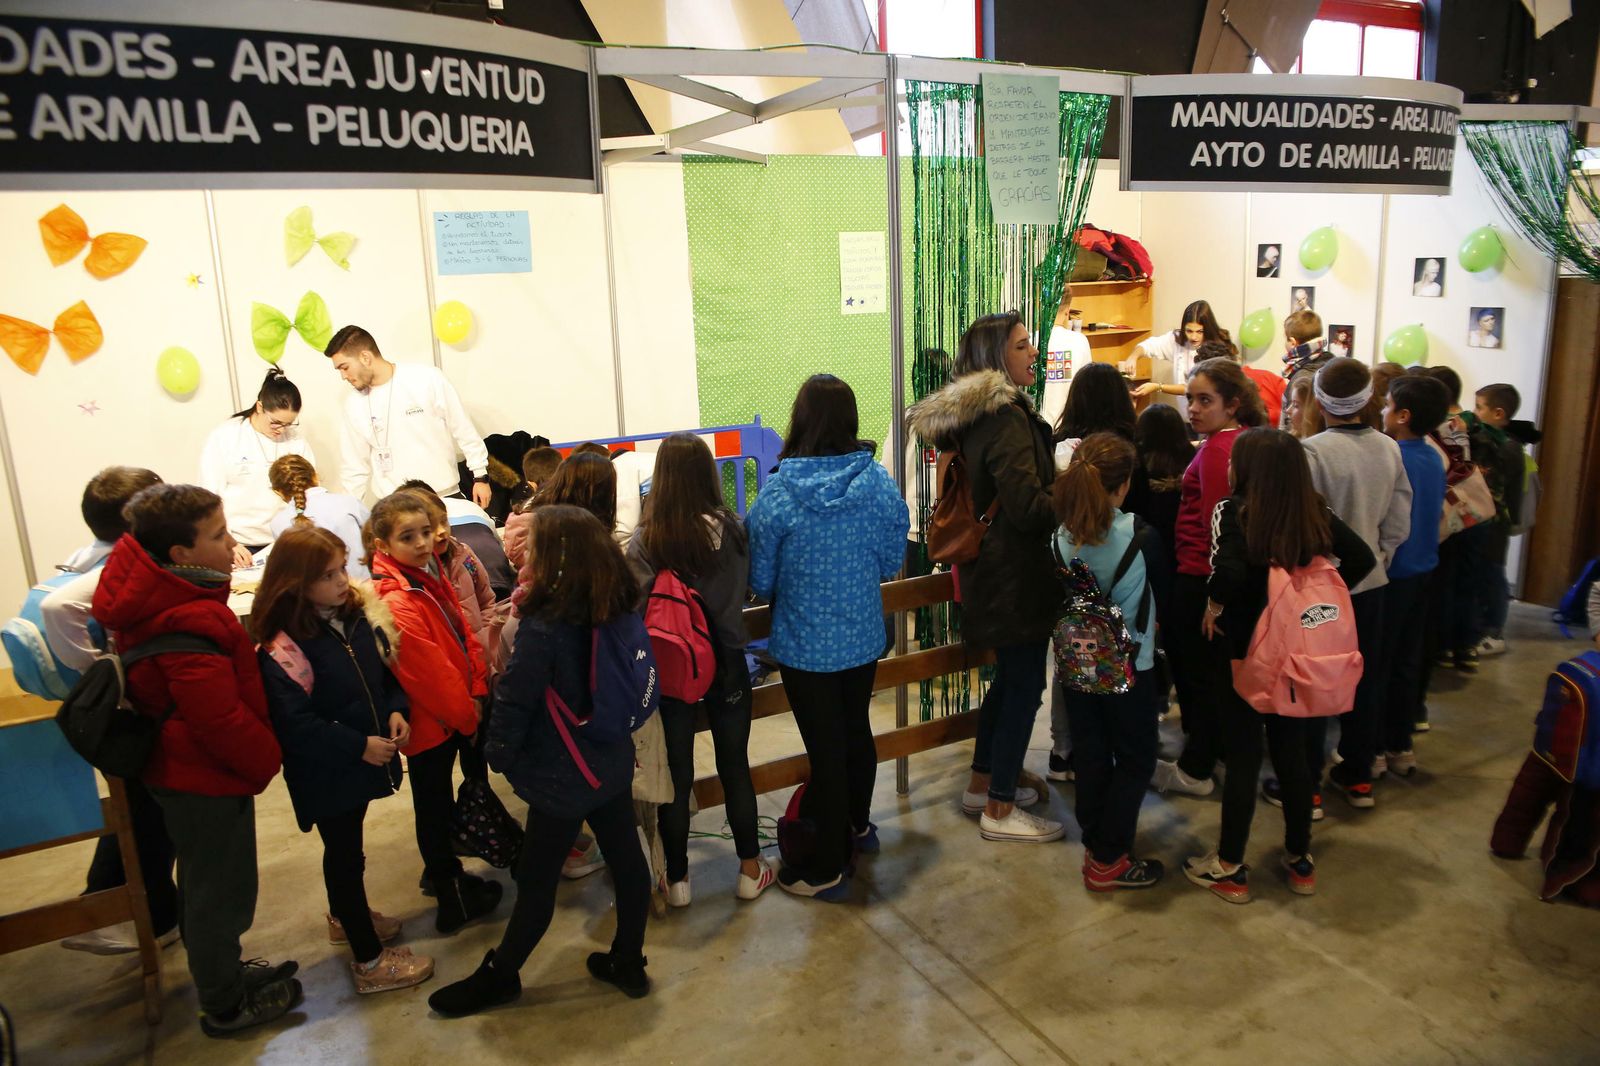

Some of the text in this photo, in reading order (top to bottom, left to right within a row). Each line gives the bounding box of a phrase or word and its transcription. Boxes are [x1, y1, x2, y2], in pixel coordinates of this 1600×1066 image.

[230, 39, 356, 89] AREA
[366, 49, 545, 106] JUVENTUD
[1033, 100, 1046, 109] EL
[1171, 102, 1375, 130] MANUALIDADES
[1390, 105, 1428, 132] AREA
[30, 94, 261, 144] ARMILLA
[307, 104, 534, 157] PELUQUERIA
[1190, 141, 1266, 168] AYTO
[1279, 143, 1312, 169] DE
[1316, 144, 1400, 170] ARMILLA
[998, 181, 1052, 207] GRACIAS
[642, 666, 656, 708] CARMEN
